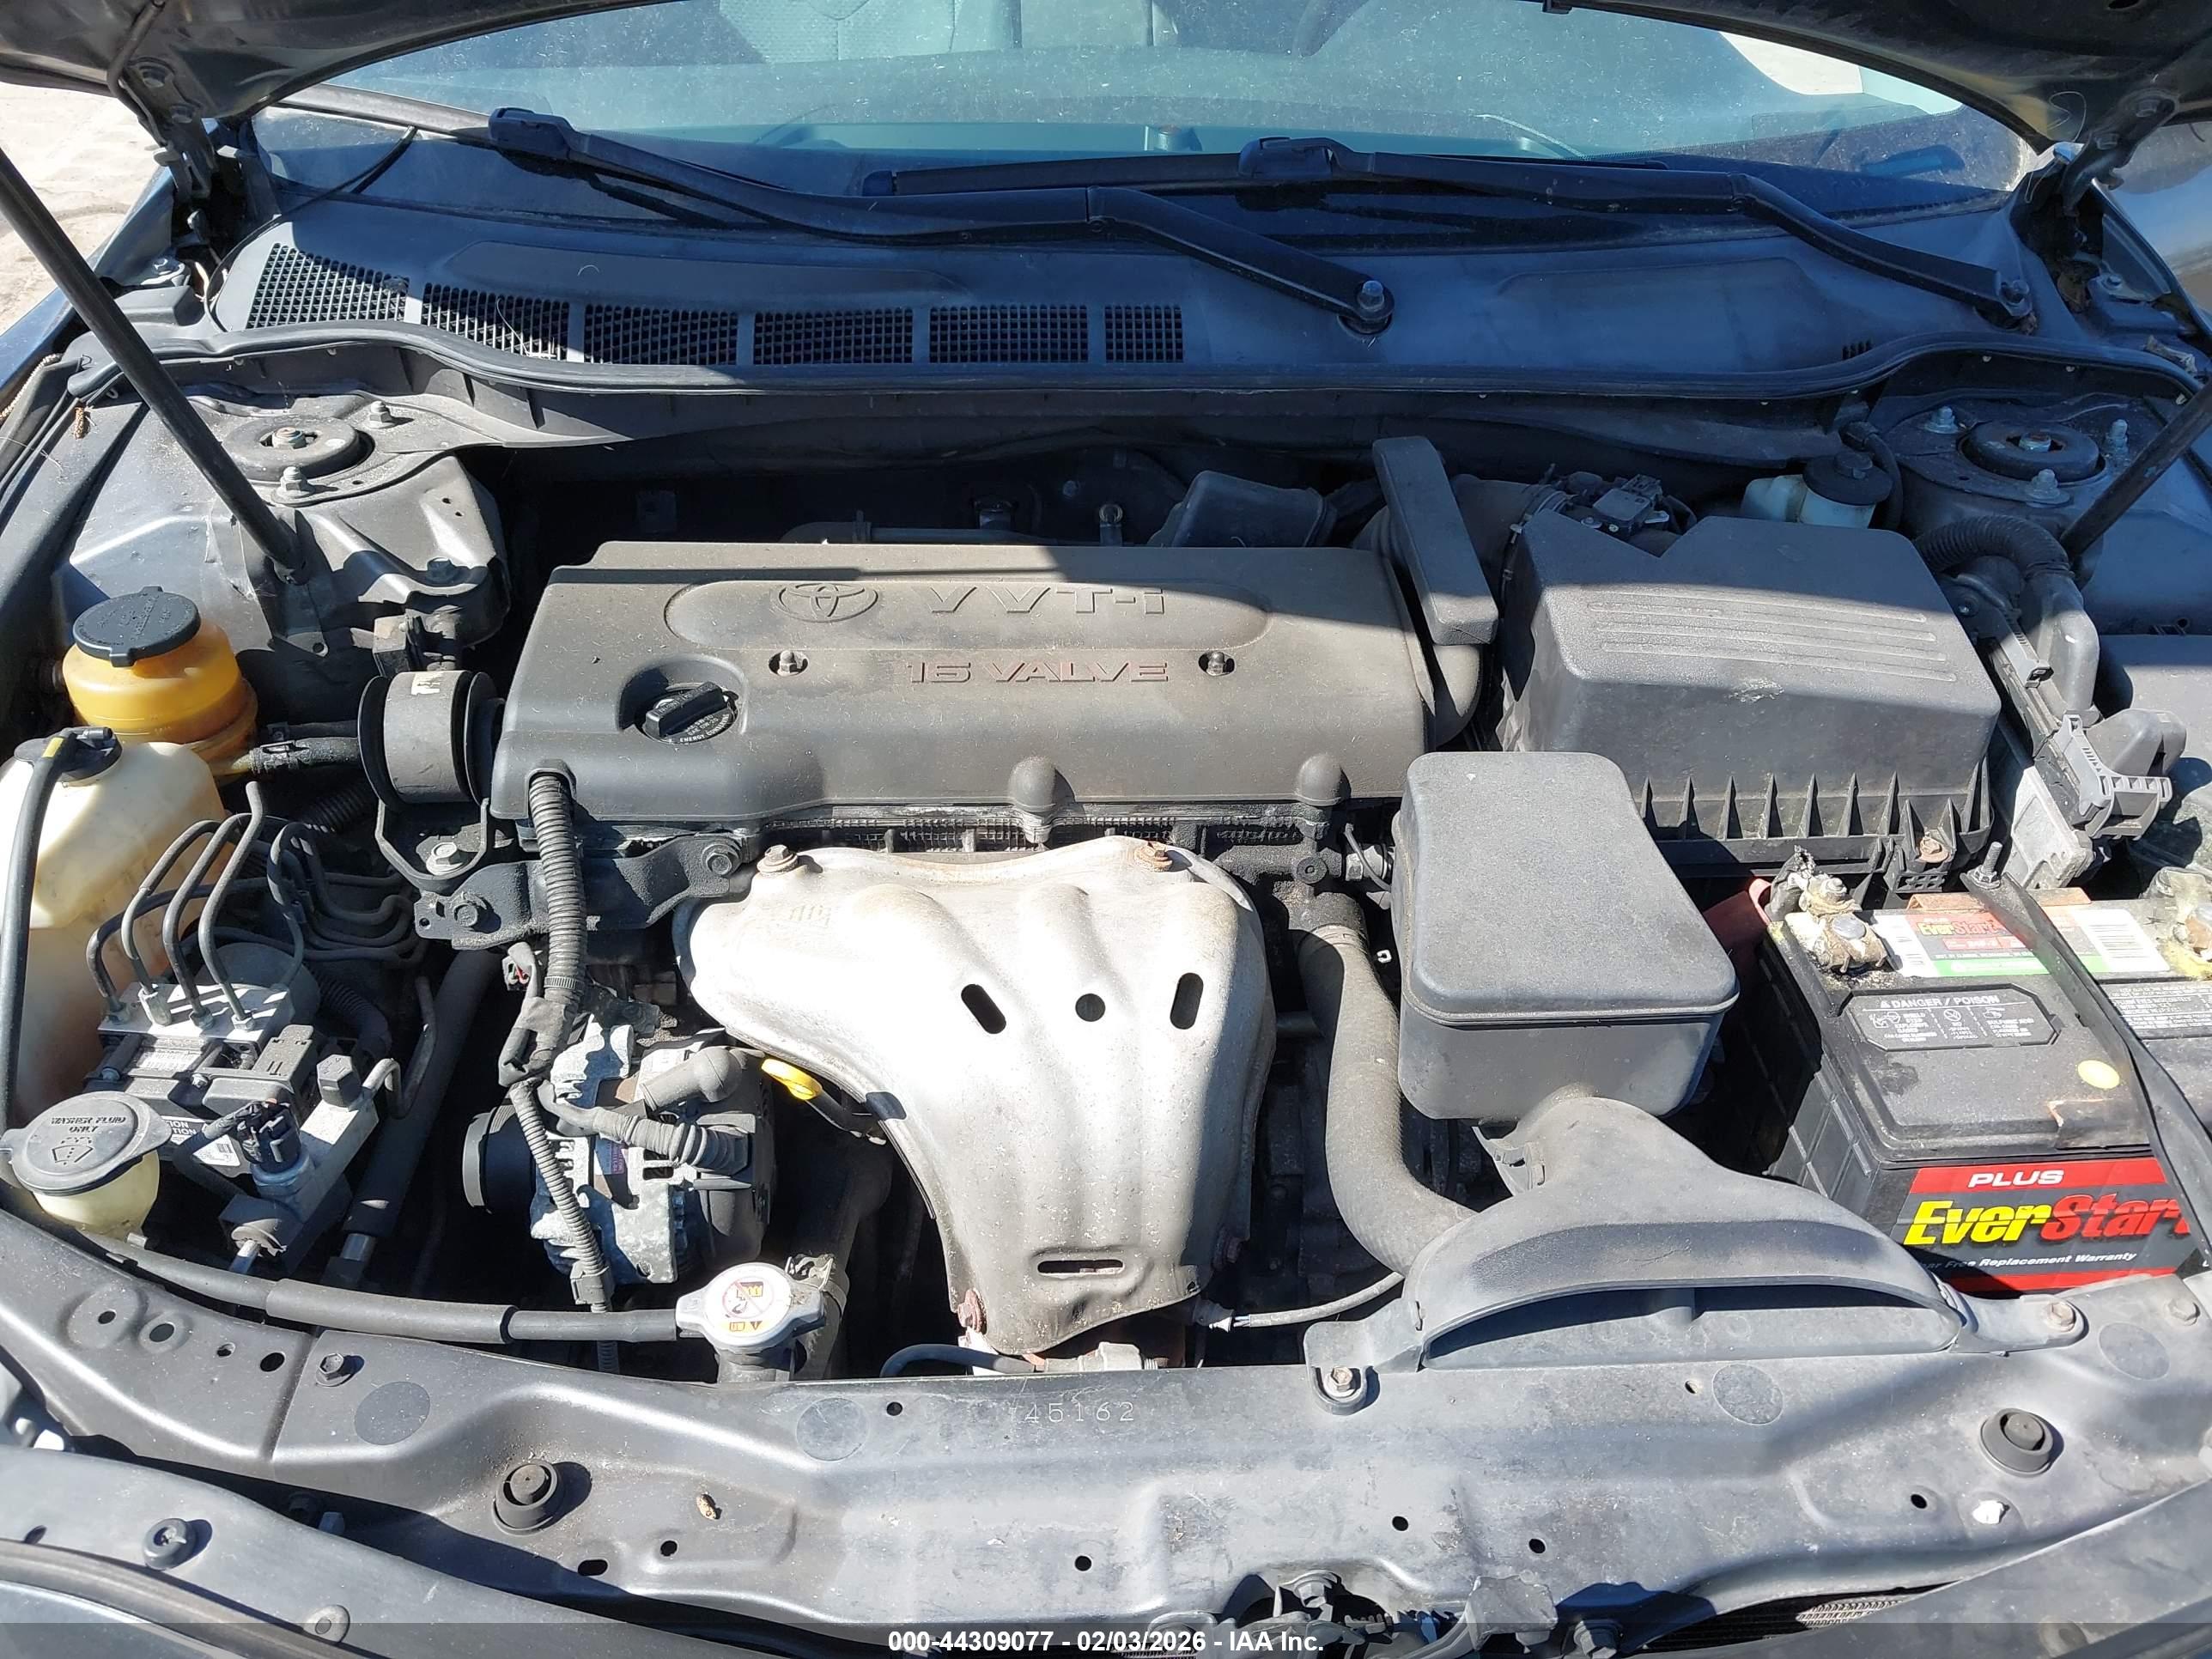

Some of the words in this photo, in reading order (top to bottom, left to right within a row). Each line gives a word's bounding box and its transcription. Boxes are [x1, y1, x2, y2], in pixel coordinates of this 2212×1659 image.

[911, 586, 1164, 614] VVT-i
[907, 662, 972, 683] 16
[987, 662, 1169, 683] VALVE
[679, 734, 706, 743] ENERGY
[1891, 997, 1942, 1008] DANGER
[1954, 994, 2001, 1006] POISON
[51, 1116, 94, 1125] WASHER
[1967, 1169, 2065, 1188] PLUS
[1947, 1260, 1976, 1269] Free
[1979, 1255, 2071, 1268] Replacement
[2075, 1251, 2136, 1264] Warranty
[1024, 1401, 1134, 1423] 45162
